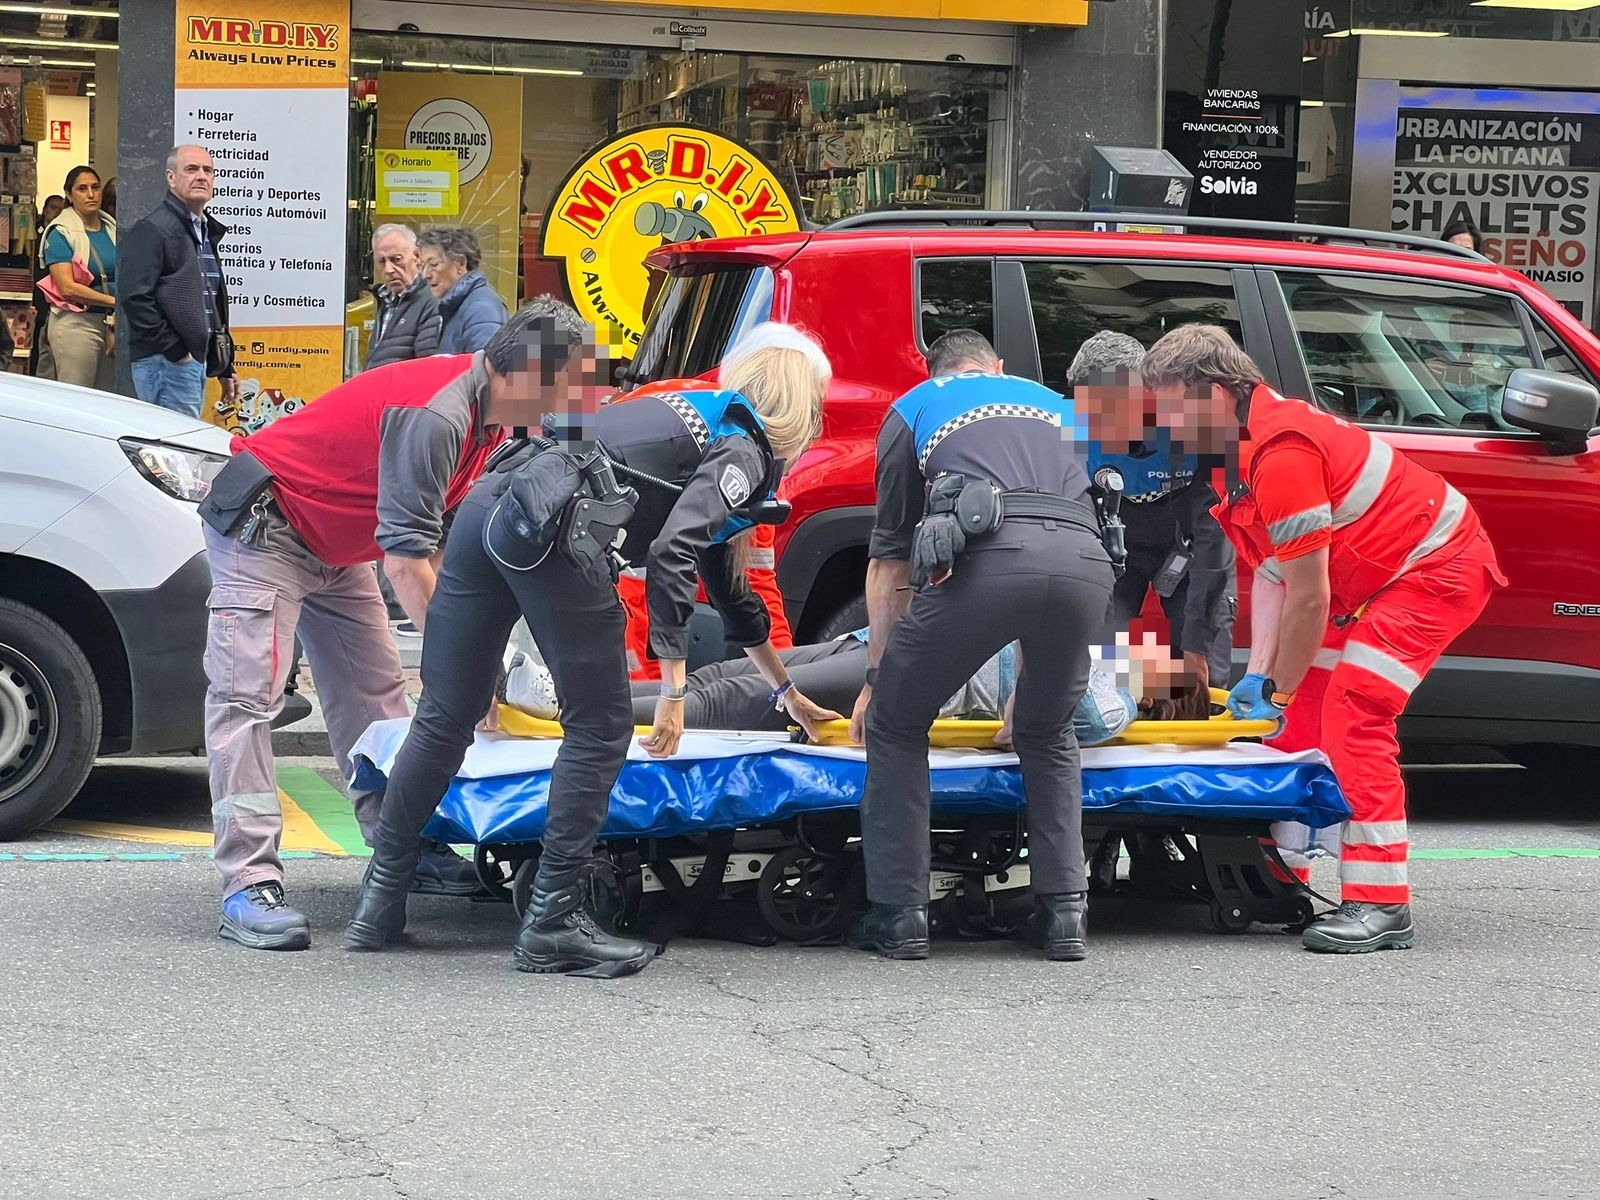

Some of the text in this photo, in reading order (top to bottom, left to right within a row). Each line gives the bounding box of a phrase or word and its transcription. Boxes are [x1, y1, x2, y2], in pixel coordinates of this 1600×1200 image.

[188, 49, 337, 68] Always Low Prices
[1207, 89, 1258, 99] VIVIENDAS
[1203, 99, 1261, 109] BANCARIAS
[198, 109, 234, 123] Hogar
[197, 127, 257, 141] Ferretería
[1182, 122, 1279, 135] FINANCIACIÓN 100%
[410, 131, 487, 146] PRECIOS BAJOS
[1203, 150, 1257, 159] VENDEDOR
[1414, 143, 1566, 166] LA FONTANA
[401, 157, 432, 166] Horario
[1197, 160, 1262, 170] AUTORIZADO
[213, 167, 265, 179] coración
[1200, 175, 1258, 195] Solvia
[212, 186, 321, 202] pelería y Deportes
[205, 205, 327, 220] ccesorios Automóvil
[1482, 231, 1586, 267] SEÑO
[269, 260, 276, 270] y
[280, 258, 332, 271] Telefonía
[253, 296, 260, 307] y
[264, 295, 325, 307] Cosmética
[268, 346, 329, 355] mrdiy.spain
